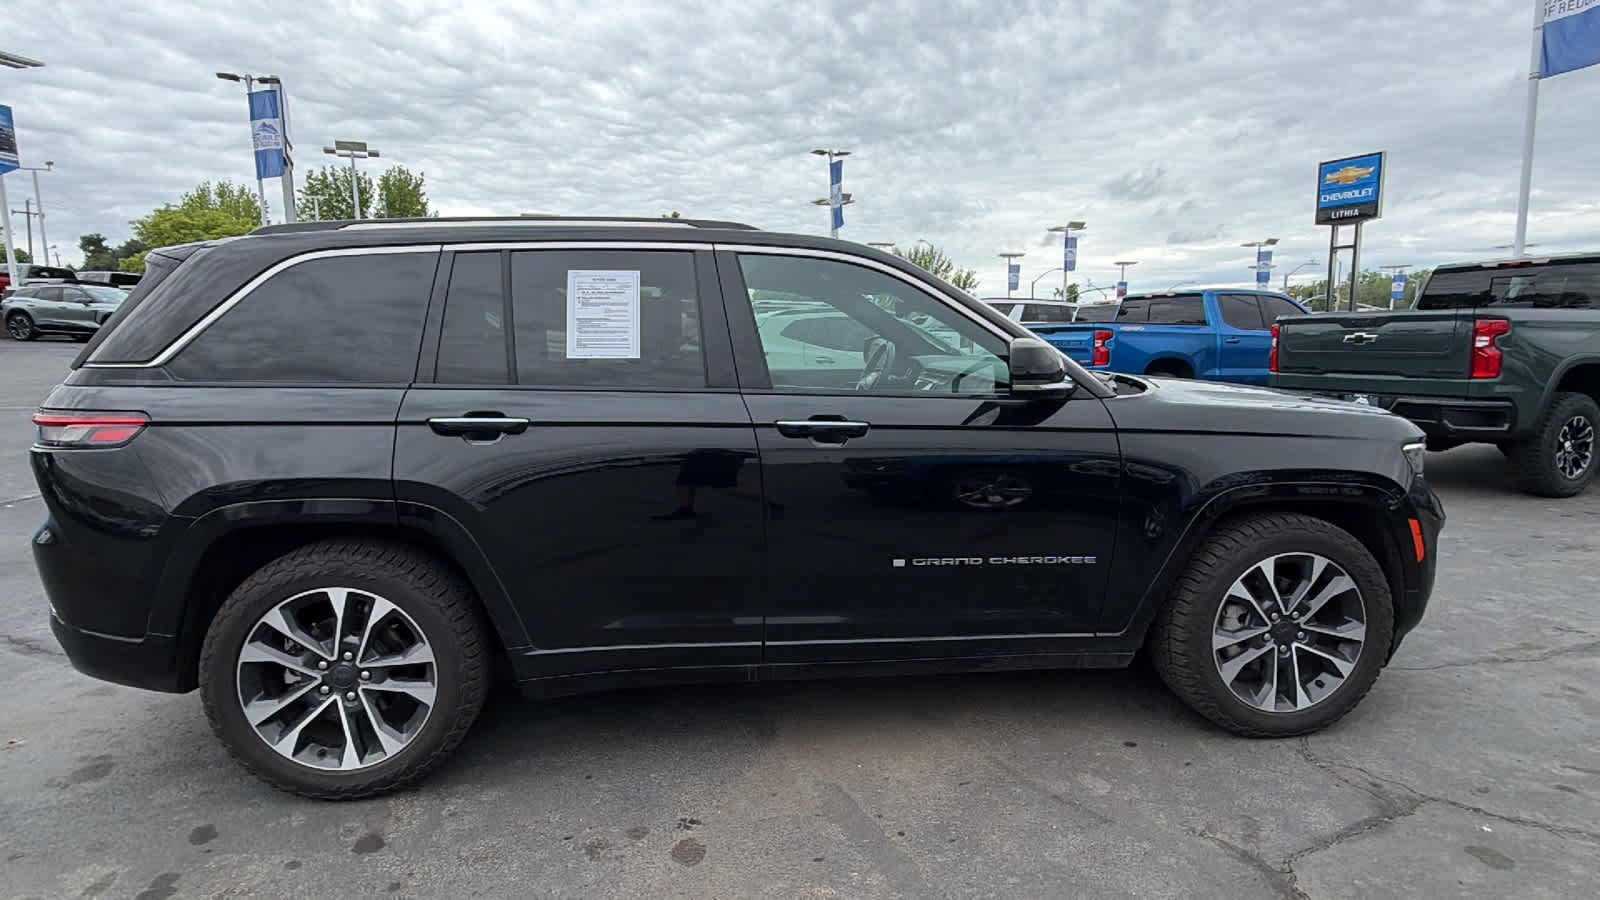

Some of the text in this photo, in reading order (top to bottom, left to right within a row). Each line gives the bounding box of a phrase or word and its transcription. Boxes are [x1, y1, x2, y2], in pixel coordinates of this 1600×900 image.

[1321, 188, 1373, 202] CHEVROLET
[1331, 208, 1359, 219] LITHIA
[912, 556, 1097, 566] GRAND CHEROKEE
